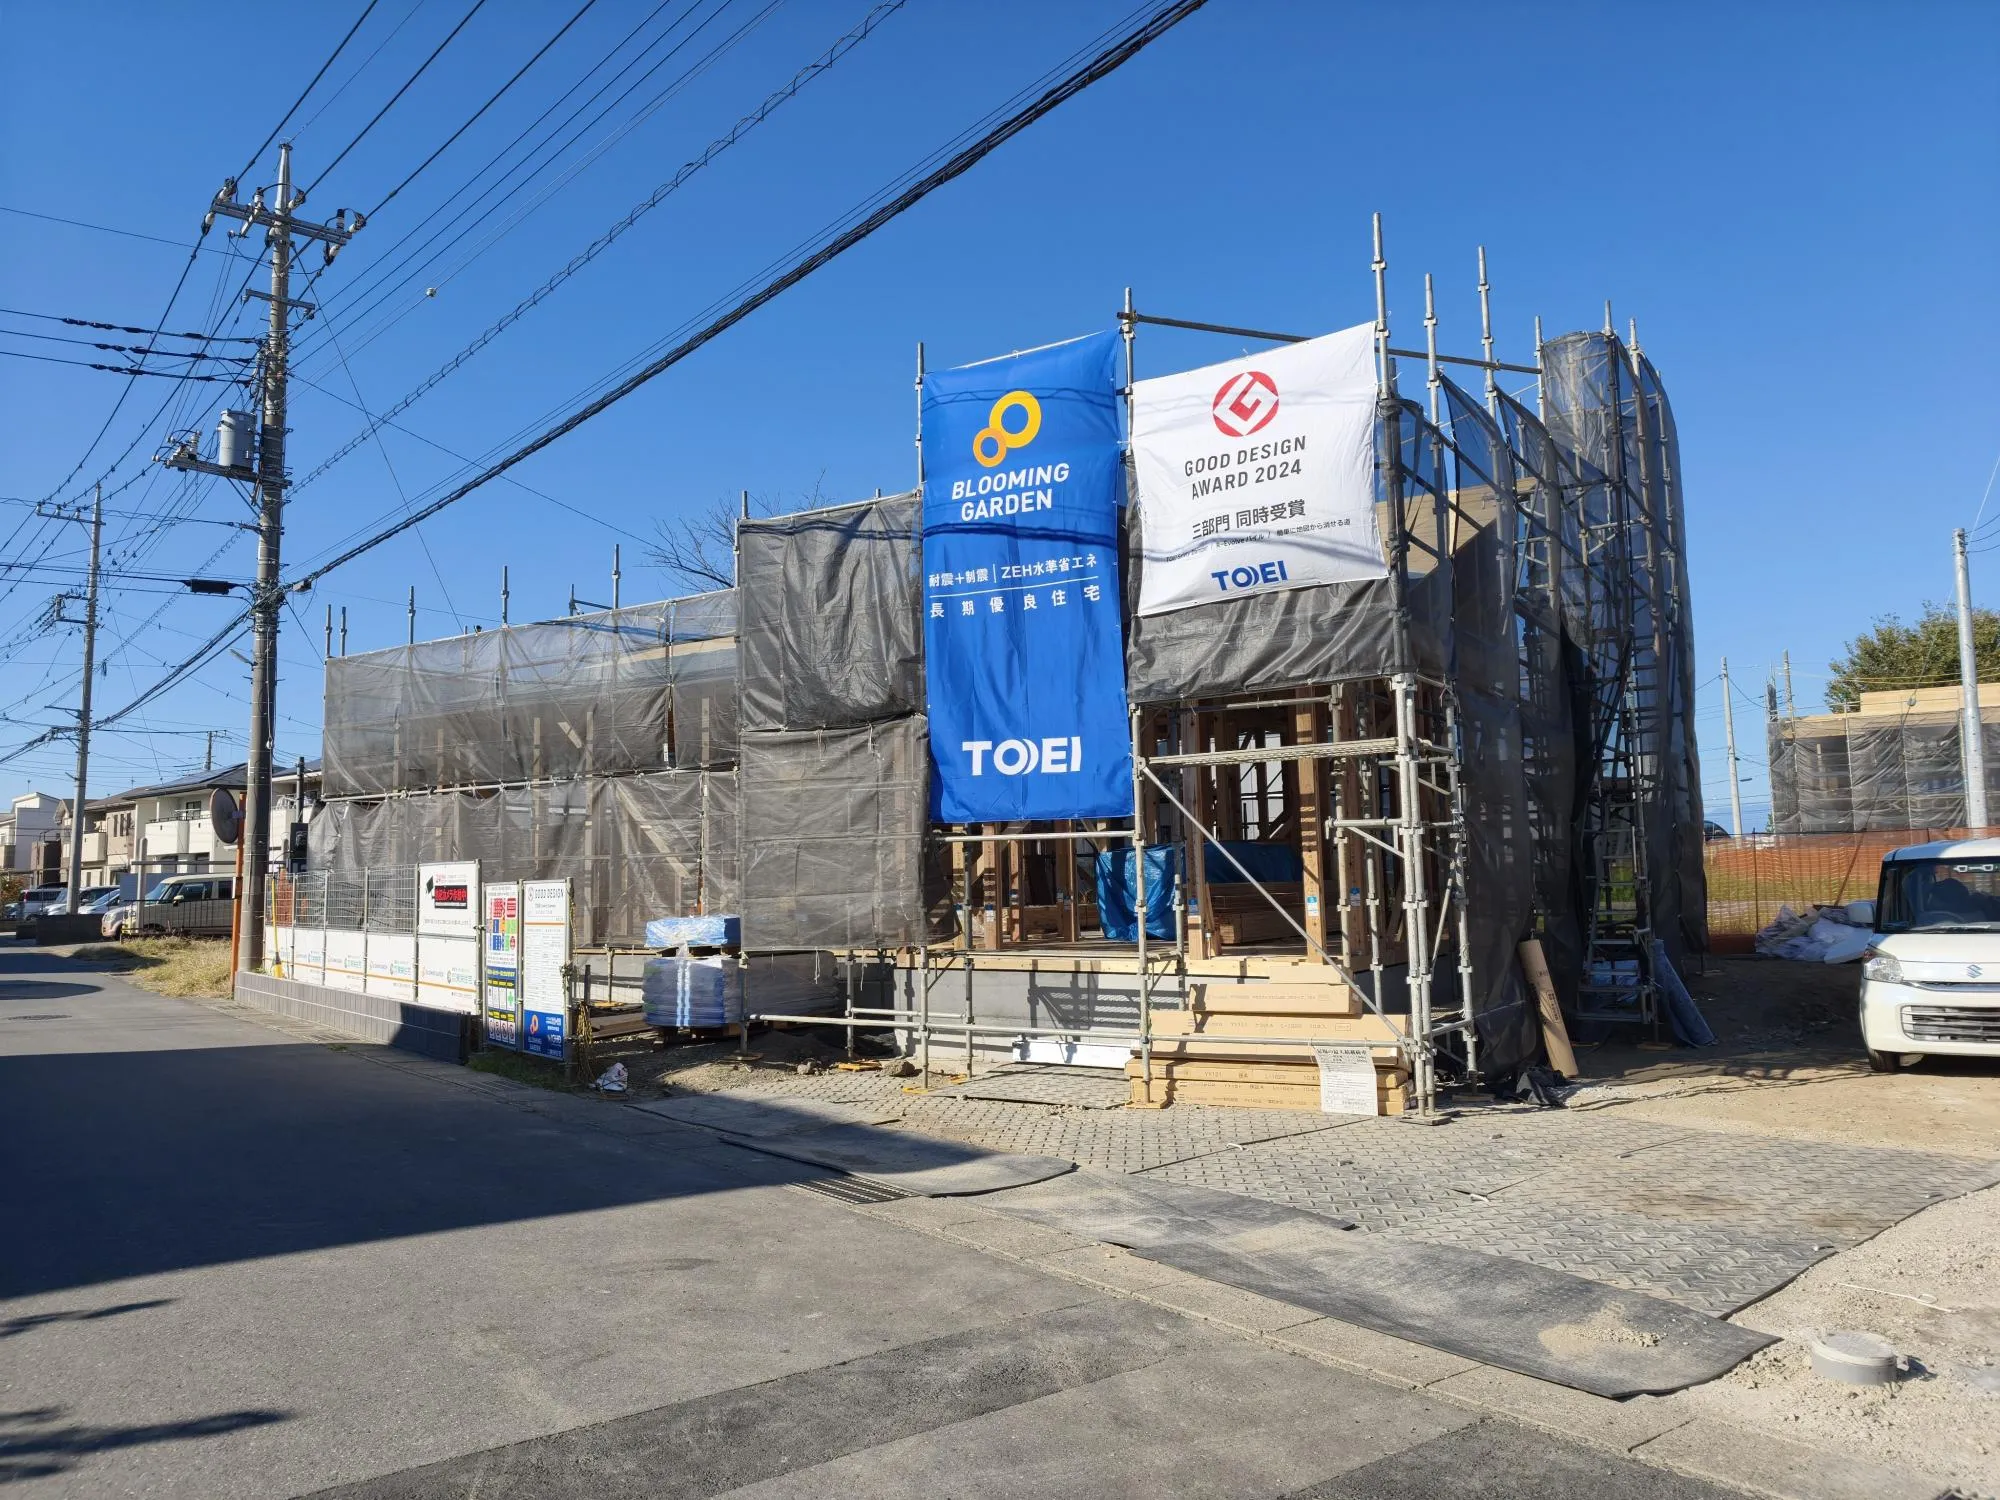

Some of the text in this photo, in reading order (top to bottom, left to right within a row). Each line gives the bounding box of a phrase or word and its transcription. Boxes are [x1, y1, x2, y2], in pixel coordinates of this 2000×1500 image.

[1184, 435, 1307, 478] GOOD DESIGN
[951, 462, 1070, 501] BLOOMING
[1190, 458, 1302, 501] AWARD 2024
[961, 488, 1053, 522] GARDEN
[1191, 498, 1307, 540] 三部門 同時受賞
[1001, 553, 1098, 580] ZEH水準省エネ
[1211, 560, 1289, 591] TOEI
[930, 585, 1101, 618] 長期優良住宅
[962, 736, 1082, 776] TOEI
